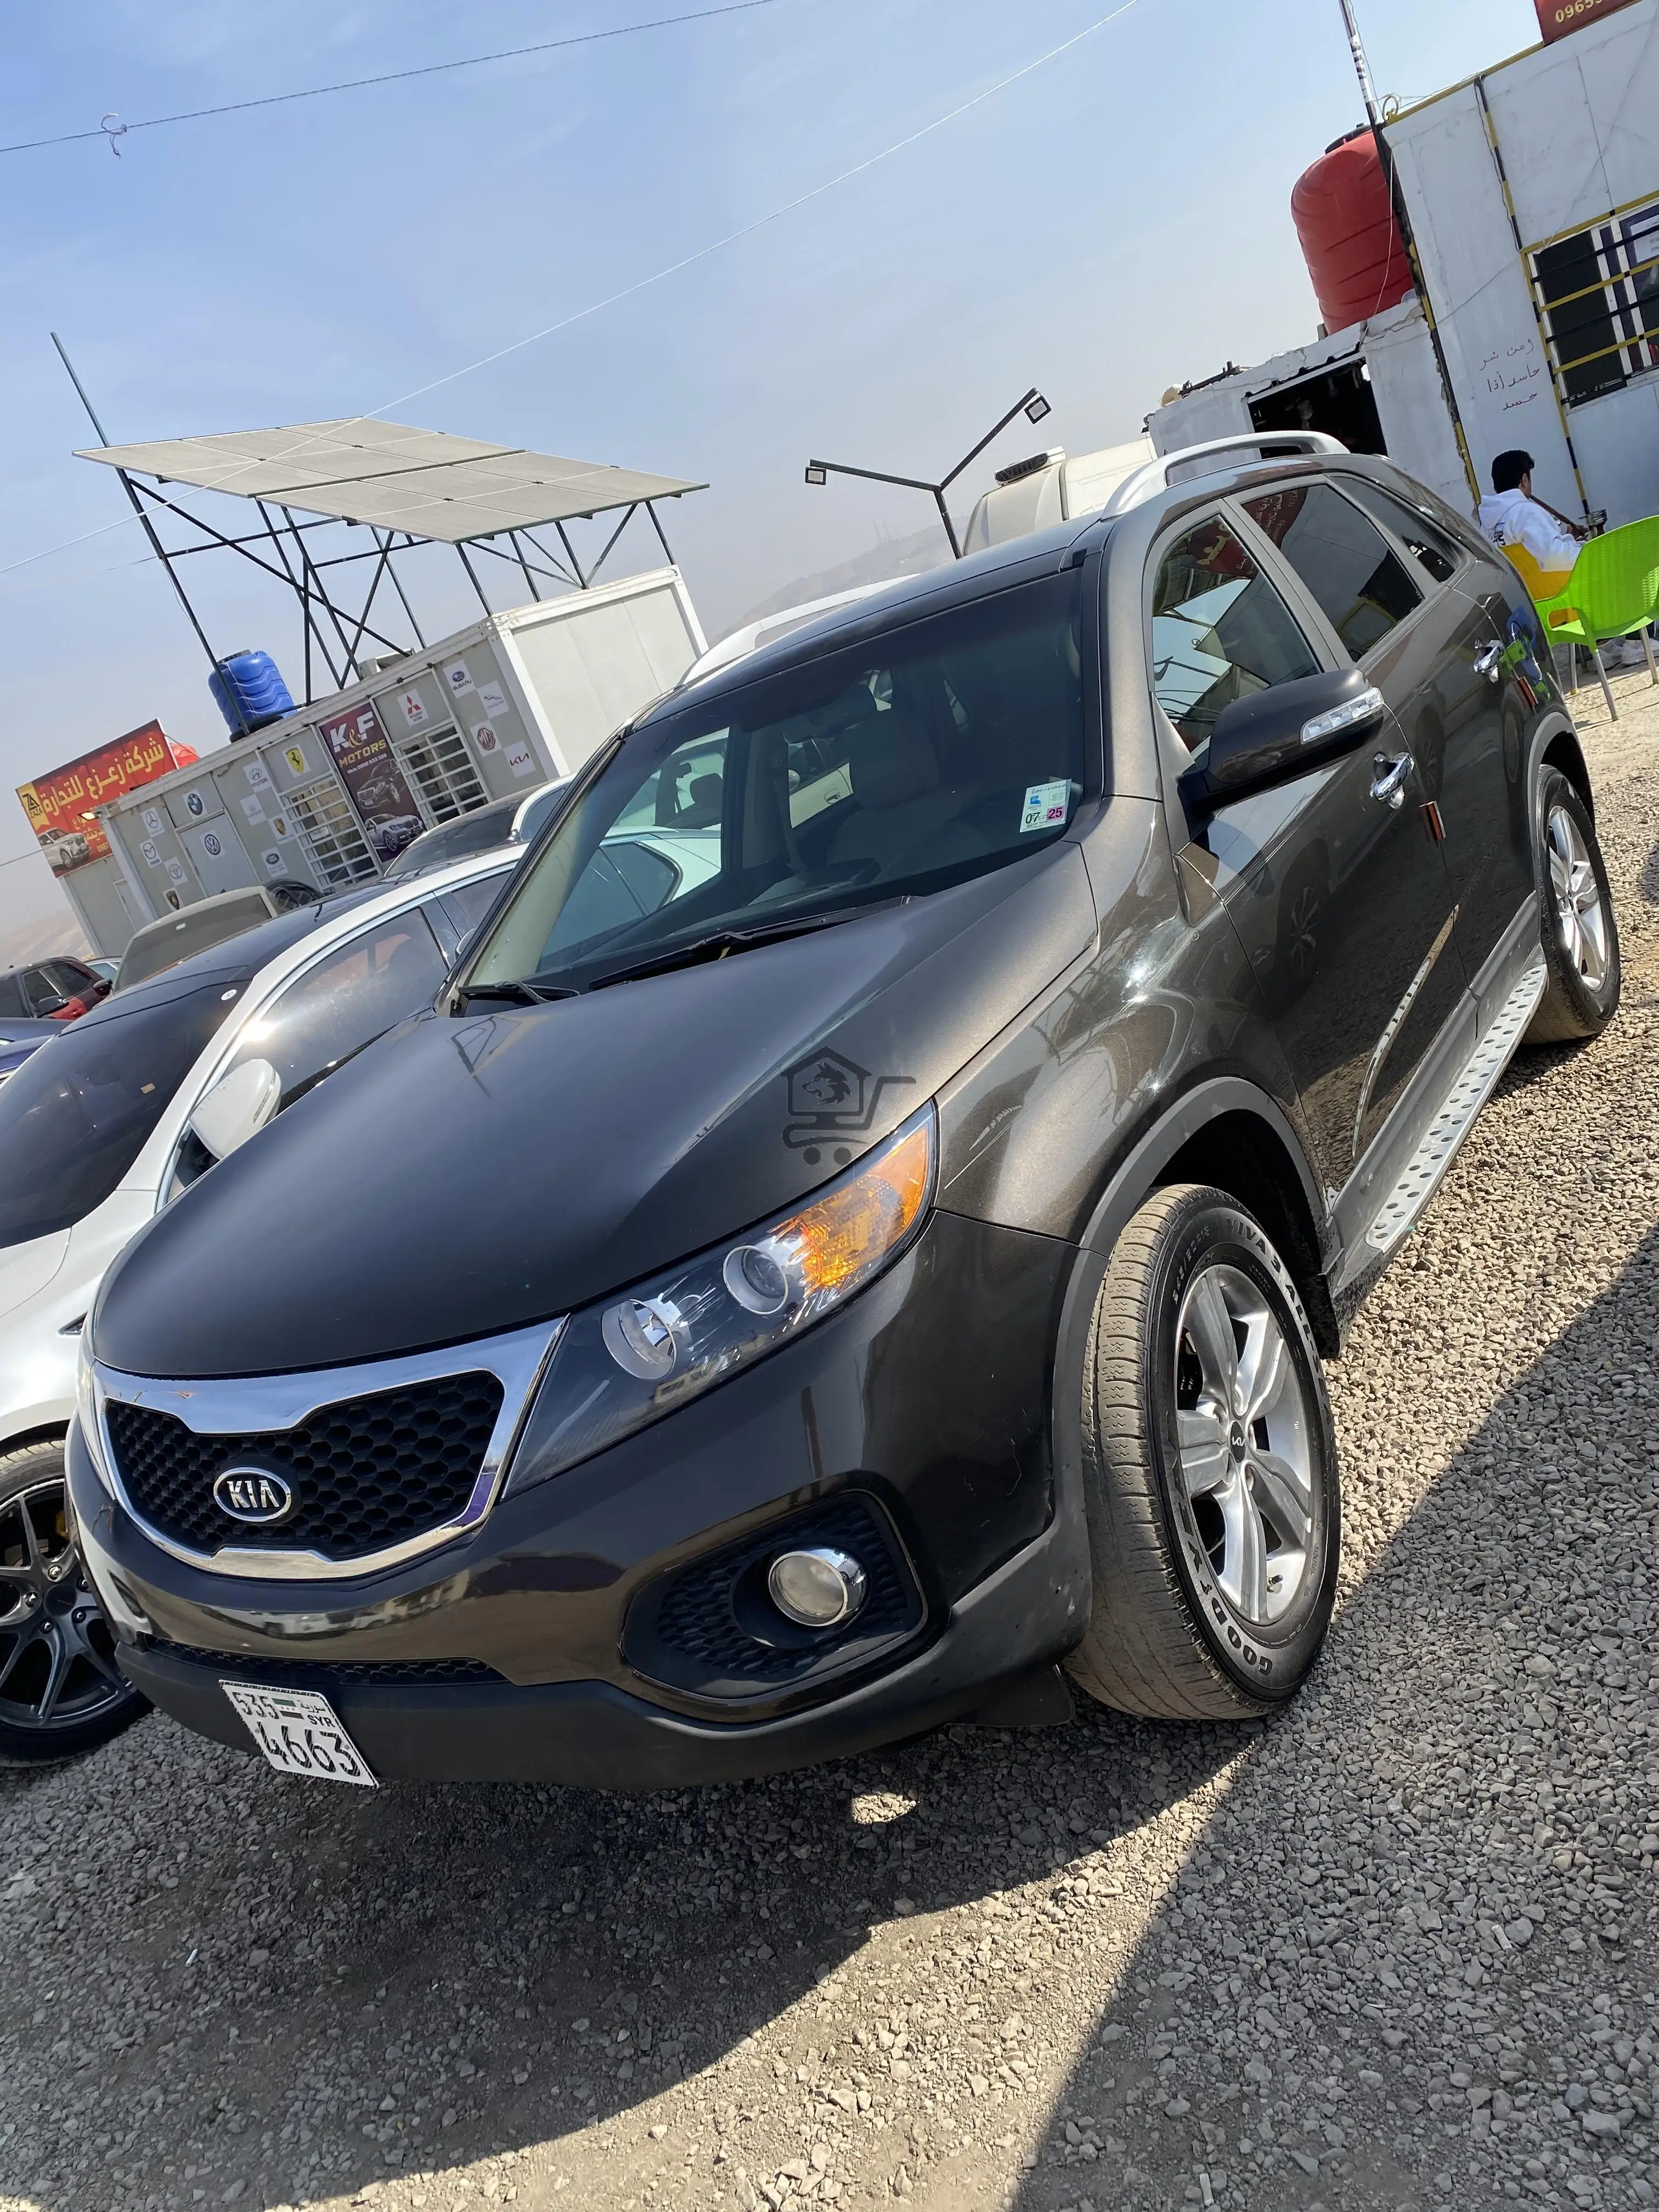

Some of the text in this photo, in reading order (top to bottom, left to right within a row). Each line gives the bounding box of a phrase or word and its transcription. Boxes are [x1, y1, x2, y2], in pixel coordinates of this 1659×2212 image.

[1478, 351, 1499, 371] شر
[1508, 364, 1540, 387] حاسد
[1503, 393, 1537, 410] حسد
[452, 678, 472, 691] SUBARU
[126, 737, 164, 773] شركة
[338, 739, 386, 768] MOTORS
[41, 774, 84, 817] للتجارة
[1025, 812, 1041, 824] 07
[1048, 807, 1063, 820] 25
[1226, 1218, 1266, 1255] VIVA
[227, 1479, 280, 1509] KIA
[232, 1691, 280, 1720] 535
[307, 1714, 336, 1728] SYR
[256, 1720, 361, 1777] 4663
